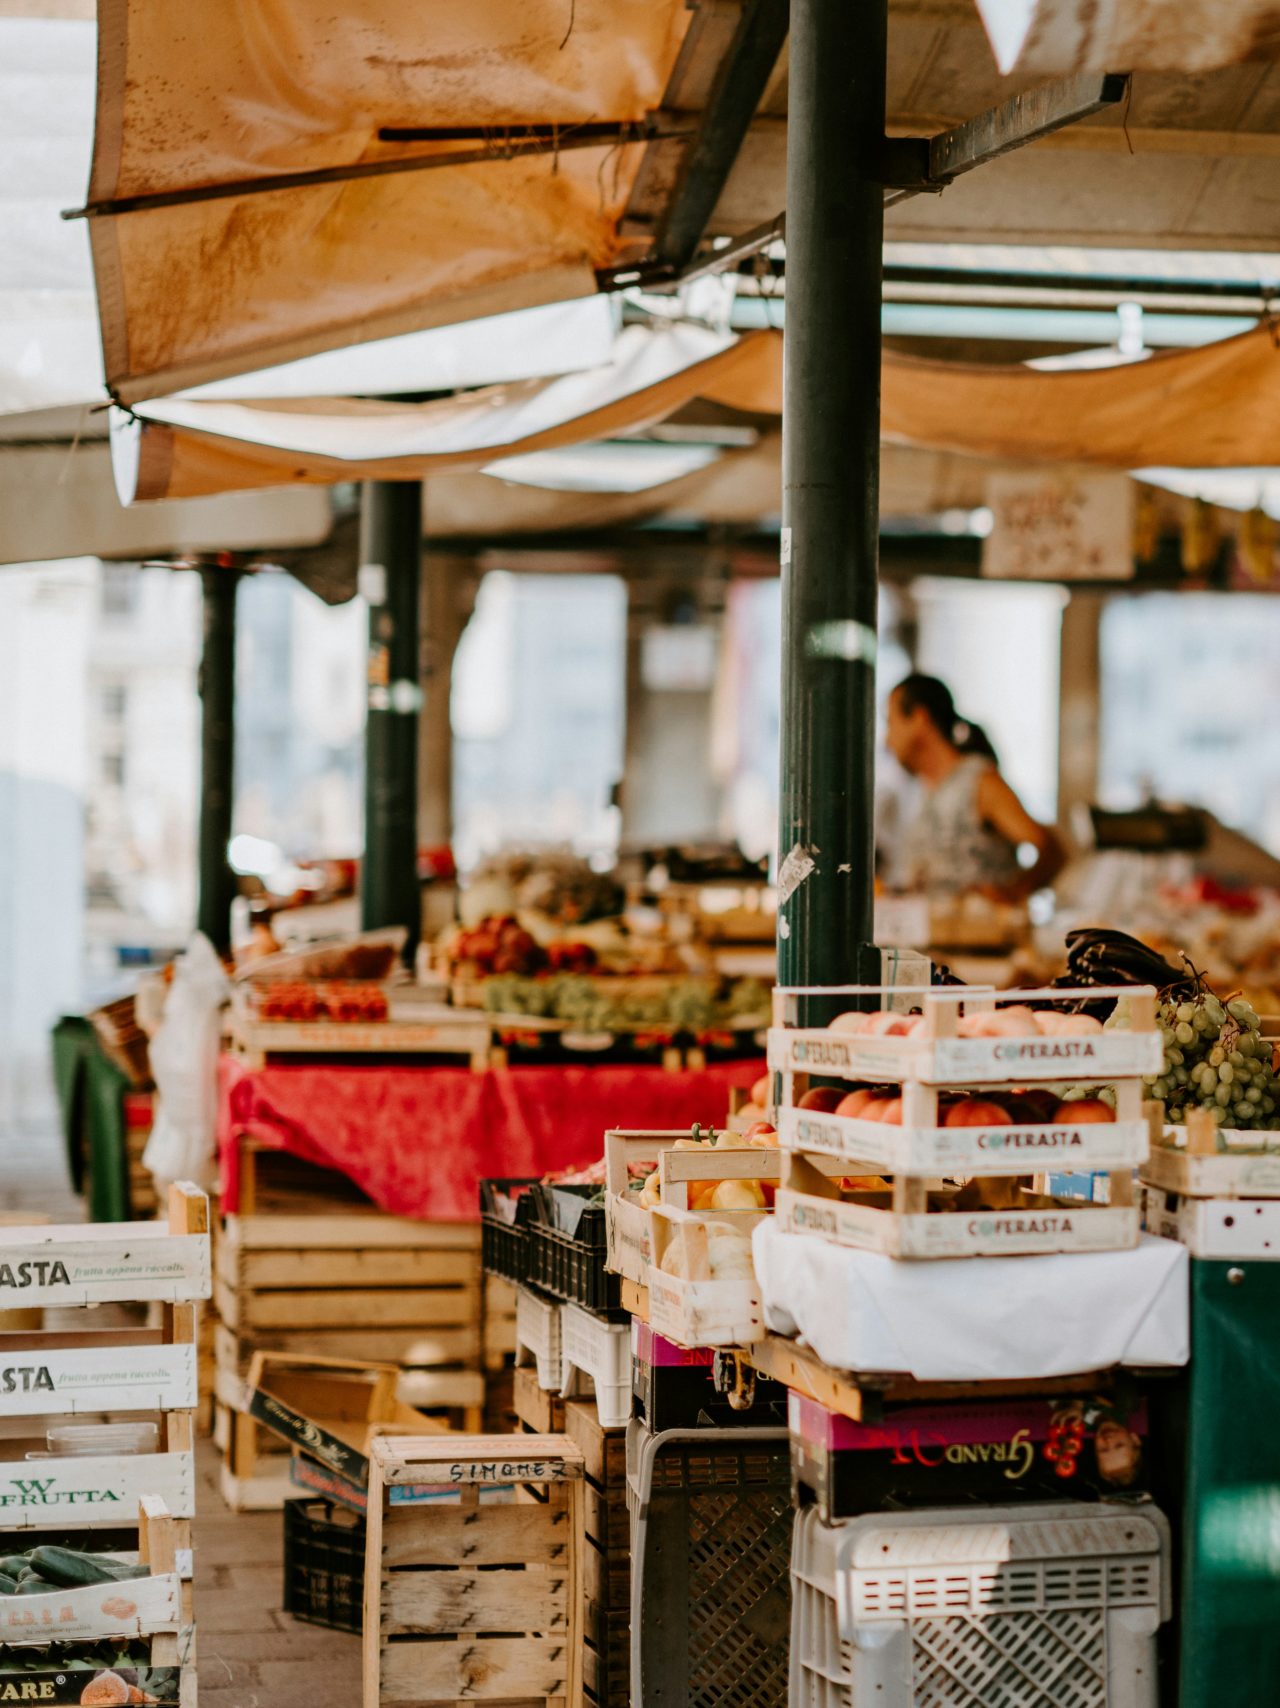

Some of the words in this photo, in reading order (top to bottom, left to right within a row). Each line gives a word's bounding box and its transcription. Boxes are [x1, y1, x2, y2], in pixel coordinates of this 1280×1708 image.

[977, 1132, 1083, 1150] COFERASTA
[967, 1217, 1073, 1236] COFERASTA
[0, 1366, 55, 1393] STA
[0, 1681, 56, 1700] ARE
